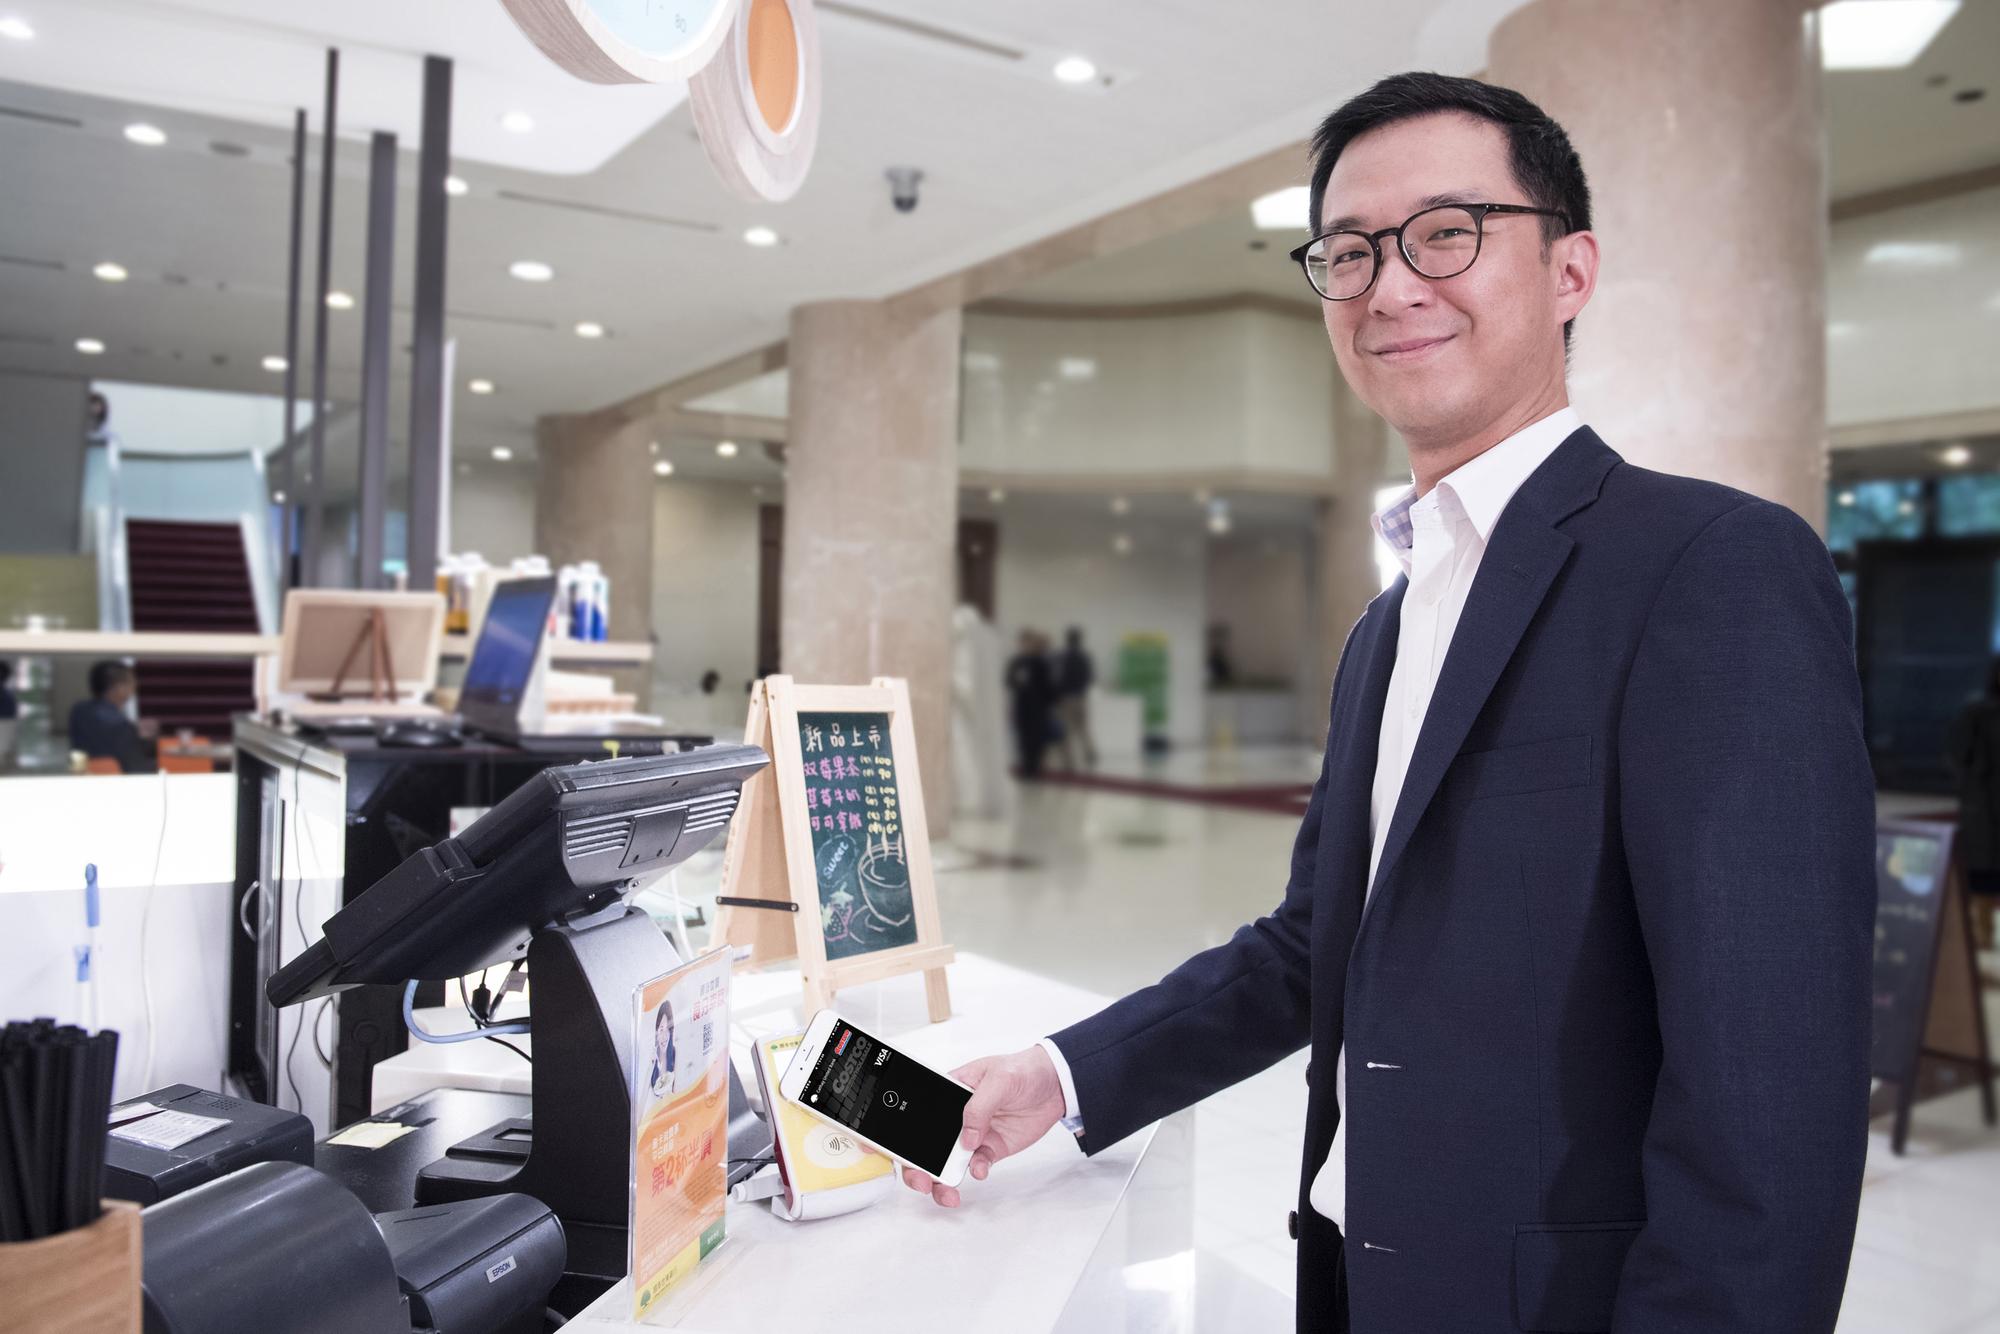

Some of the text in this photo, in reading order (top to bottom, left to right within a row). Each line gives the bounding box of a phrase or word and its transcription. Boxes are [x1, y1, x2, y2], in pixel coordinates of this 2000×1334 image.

[803, 723, 881, 752] 新品上市
[873, 1047, 889, 1067] VISA
[492, 1261, 511, 1277] EPSON
